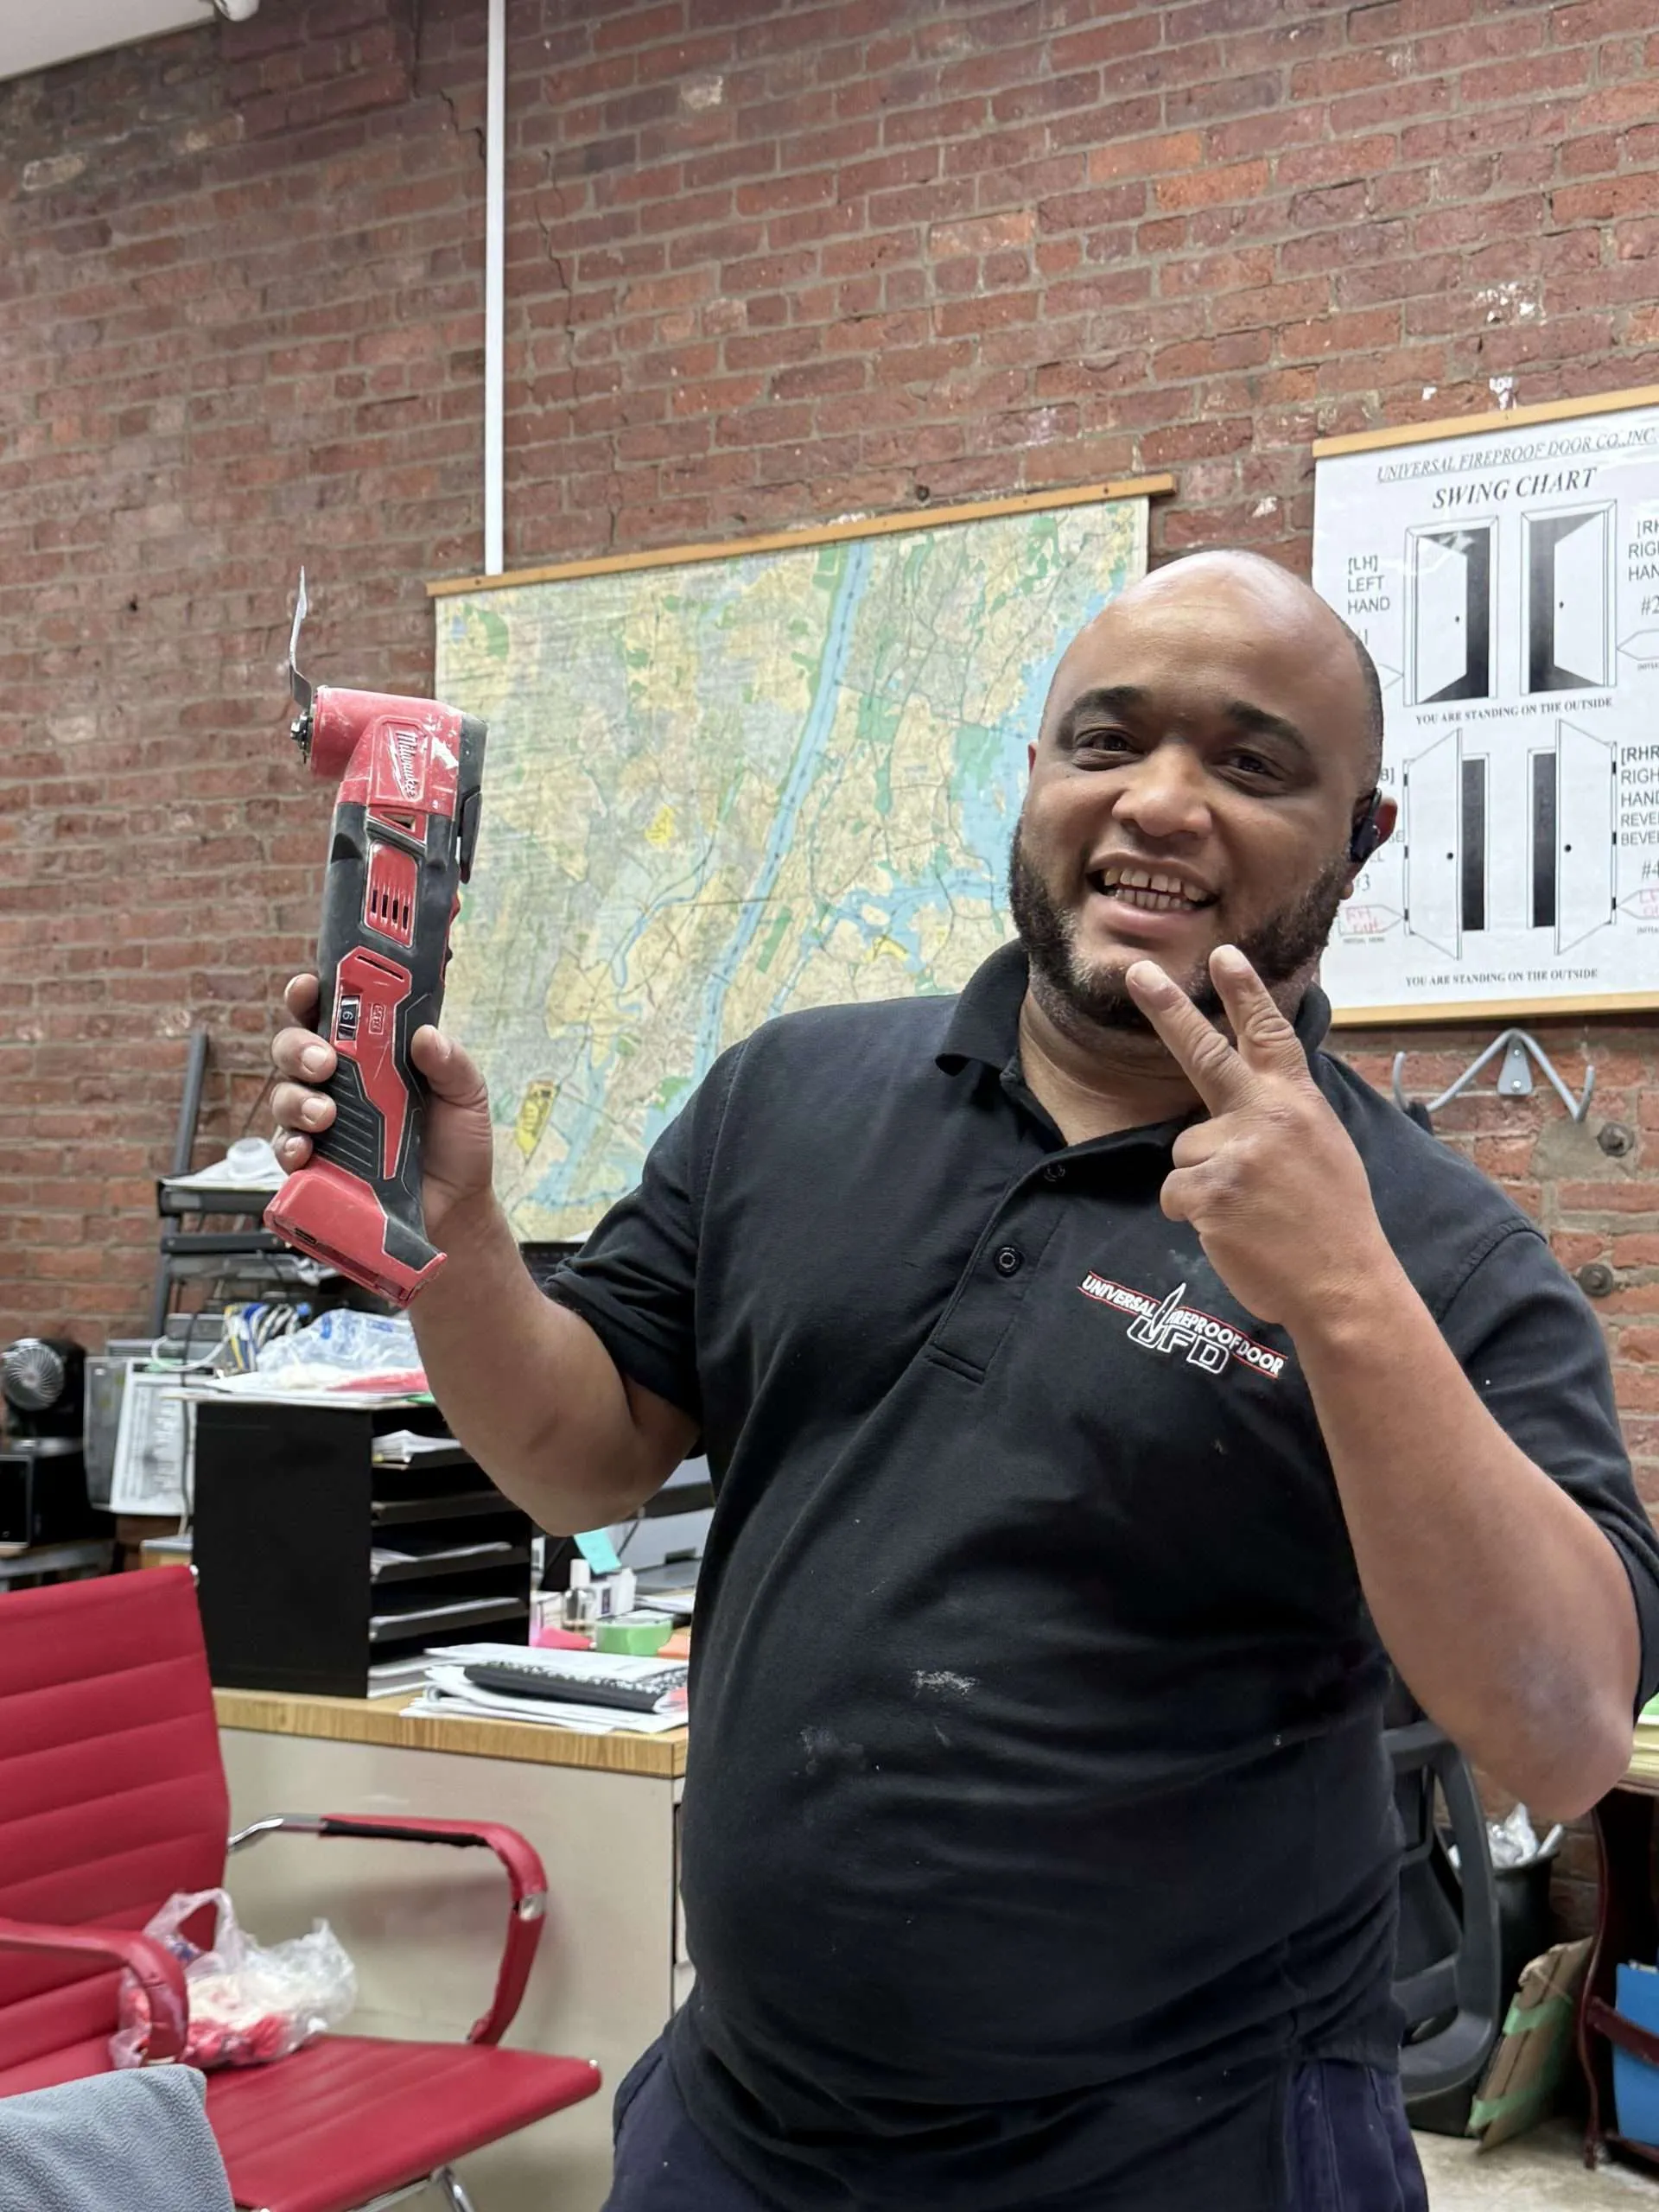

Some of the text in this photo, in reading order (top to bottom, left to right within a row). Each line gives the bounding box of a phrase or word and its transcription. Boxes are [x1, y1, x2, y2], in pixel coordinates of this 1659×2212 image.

[1377, 455, 1456, 483] UNIVERSAL
[1459, 442, 1545, 472] FIREPROOF
[1548, 435, 1592, 457] DOOR
[1433, 467, 1597, 509] SWING CHART
[1629, 540, 1659, 559] RIG
[1348, 575, 1385, 594] LEFT
[1348, 595, 1390, 616] HAND
[1415, 696, 1613, 726] YOU ARE STANDING ON THE OUTSIDE
[1621, 811, 1659, 828] REVE
[1621, 830, 1659, 848] BEVE
[1405, 967, 1598, 988] YOU ARE STANDING ON THE OUTSIDE
[1082, 1274, 1156, 1318] UNIVERSAL
[1126, 1315, 1230, 1374] UFD
